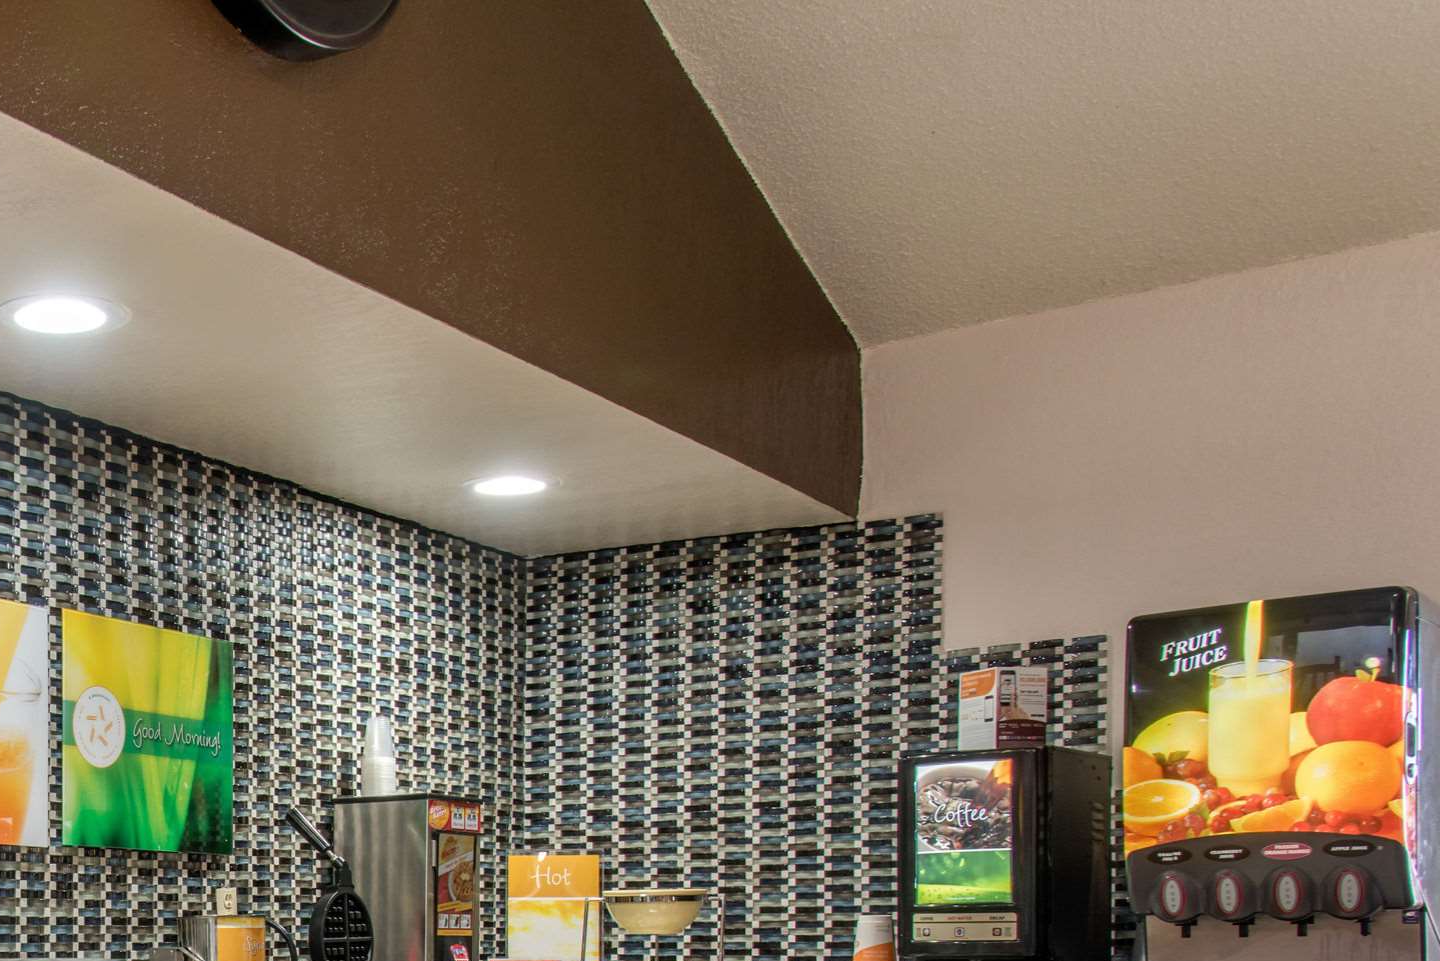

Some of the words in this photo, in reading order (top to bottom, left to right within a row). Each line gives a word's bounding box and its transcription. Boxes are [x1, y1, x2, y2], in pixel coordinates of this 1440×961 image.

[1160, 628, 1224, 661] FRUIT
[1168, 646, 1228, 676] JUICE
[133, 718, 162, 748] Good
[165, 725, 221, 756] Morning!
[934, 801, 989, 828] Coffee
[530, 863, 572, 889] Hot
